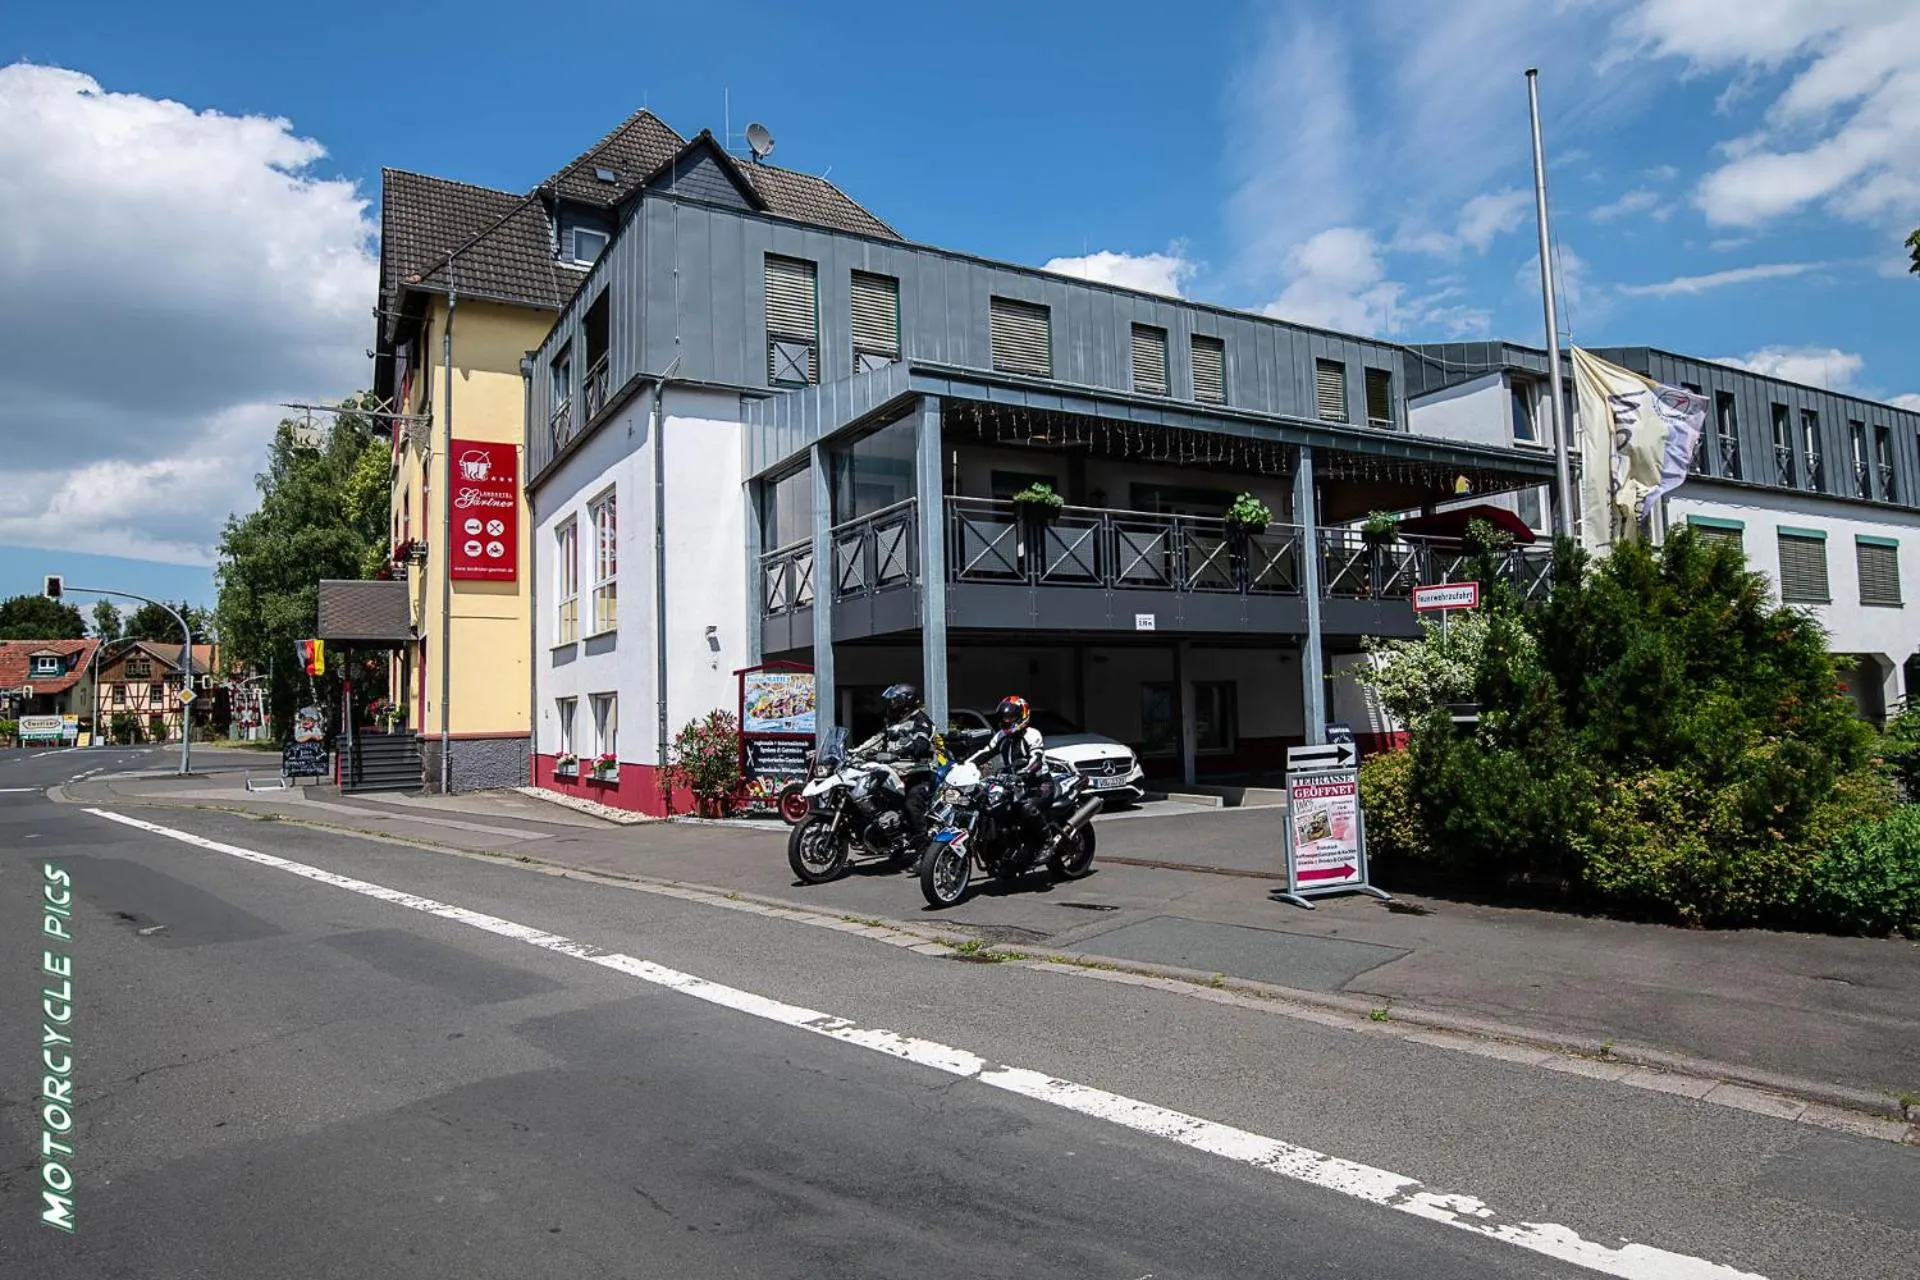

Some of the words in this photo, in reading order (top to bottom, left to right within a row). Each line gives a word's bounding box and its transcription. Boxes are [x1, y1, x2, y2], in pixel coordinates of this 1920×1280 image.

[454, 487, 514, 508] Gärtner
[1418, 592, 1473, 602] Feuerwehrzufahrt
[1293, 774, 1354, 787] TERRASSE
[1294, 784, 1354, 799] GEÖFFNET
